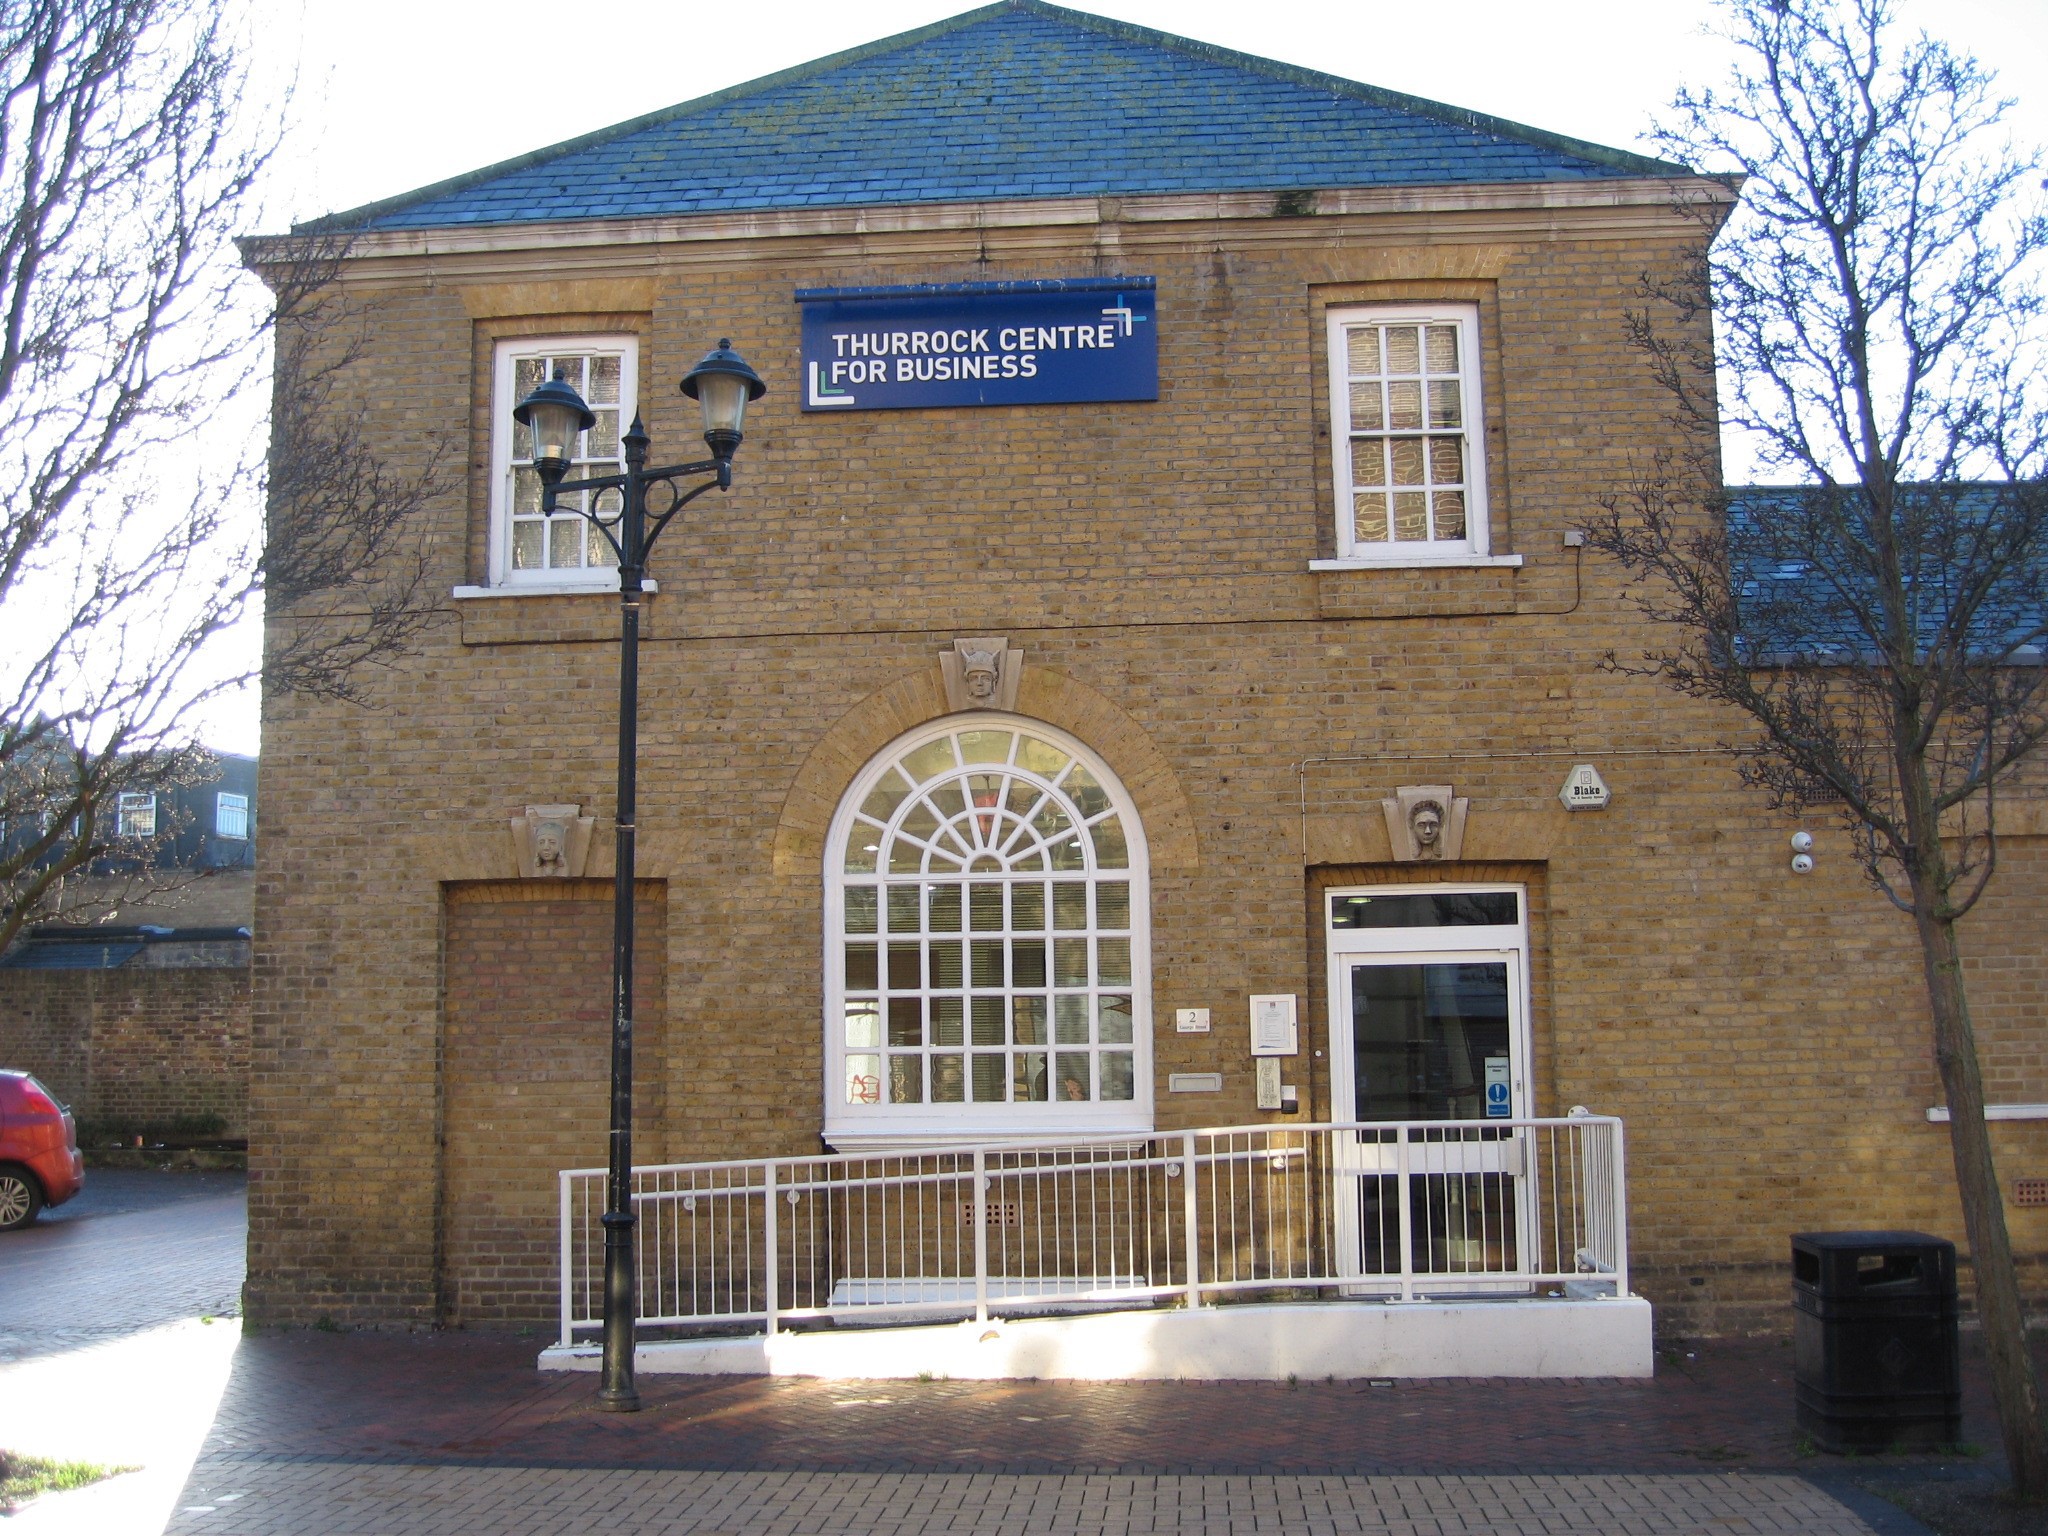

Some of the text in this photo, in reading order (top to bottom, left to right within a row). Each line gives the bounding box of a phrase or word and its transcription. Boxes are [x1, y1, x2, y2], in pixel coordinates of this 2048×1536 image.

[832, 324, 1115, 357] THURROCK CENTRE
[832, 354, 1037, 384] FOR BUSINESS
[1574, 785, 1600, 795] Blake
[1189, 1011, 1196, 1023] 2
